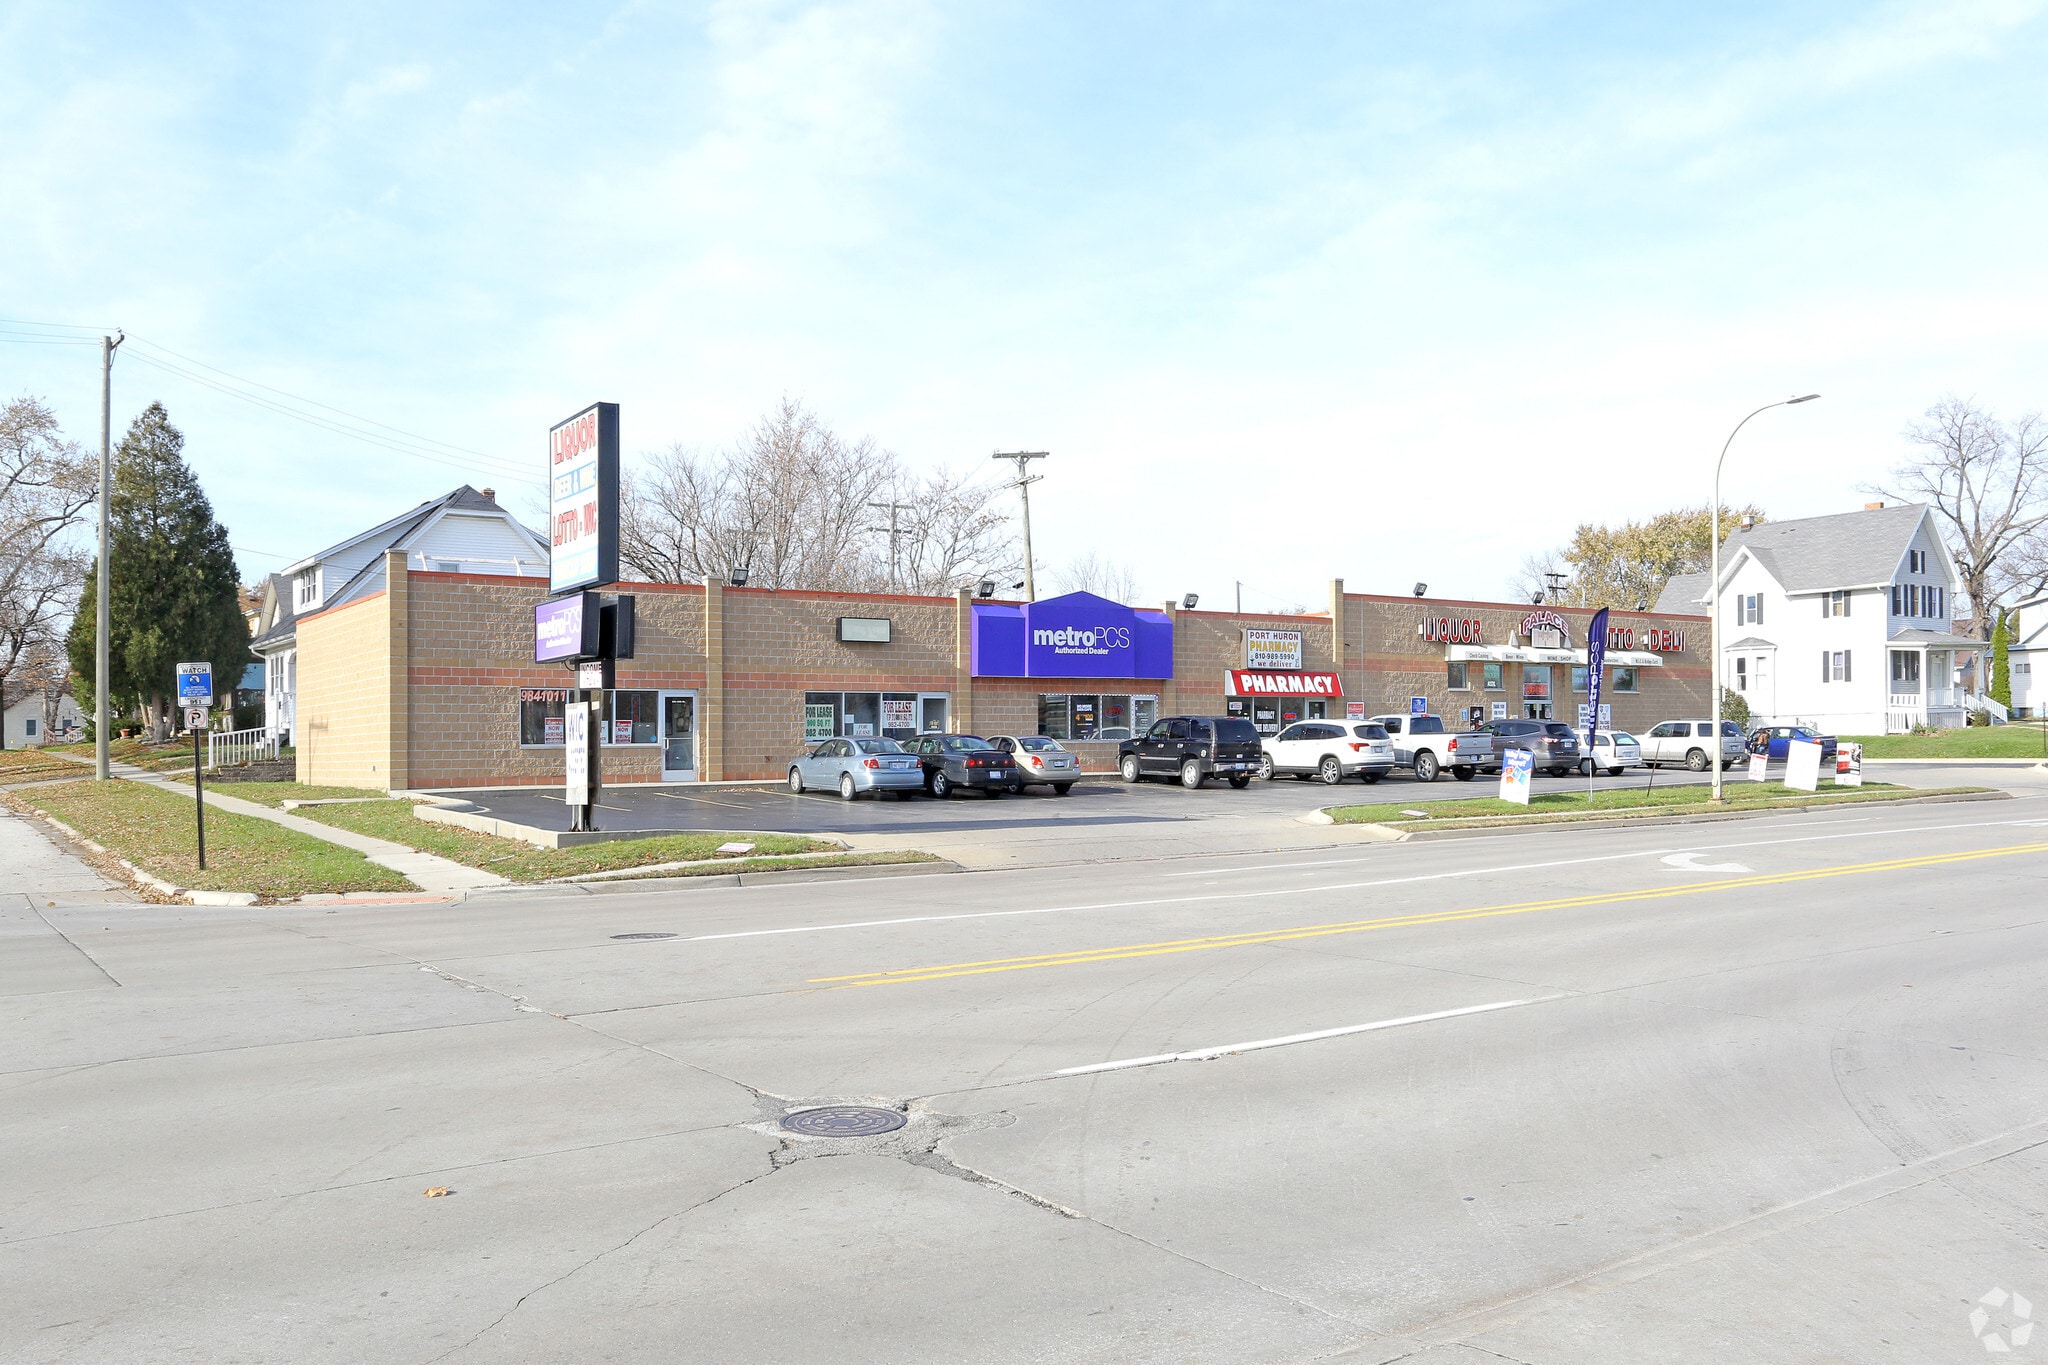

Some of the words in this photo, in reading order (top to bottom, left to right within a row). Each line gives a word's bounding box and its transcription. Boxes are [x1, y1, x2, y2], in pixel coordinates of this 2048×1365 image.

[554, 413, 596, 465] LIQUOR
[553, 509, 578, 547] LOTTO
[537, 609, 582, 640] metroPCS
[1522, 610, 1569, 637] PALACE
[1034, 626, 1130, 649] metroPCS
[1250, 632, 1270, 640] PORT
[1273, 632, 1299, 640] HURON
[1423, 617, 1483, 645] LIQUOR
[1604, 627, 1635, 649] TTO
[1649, 629, 1686, 653] DELI
[1054, 646, 1088, 655] Authorized
[1089, 647, 1109, 655] Dealer
[1250, 641, 1298, 653] PHARMACY
[1240, 674, 1333, 693] PHARMACY
[521, 690, 566, 702] 9841011
[805, 706, 816, 718] FOR
[817, 706, 832, 718] LEASE
[884, 702, 894, 713] FOR
[895, 702, 912, 713] LEASE
[1257, 711, 1275, 720] PHARMACY
[806, 728, 816, 737] 982
[818, 728, 832, 737] 4700
